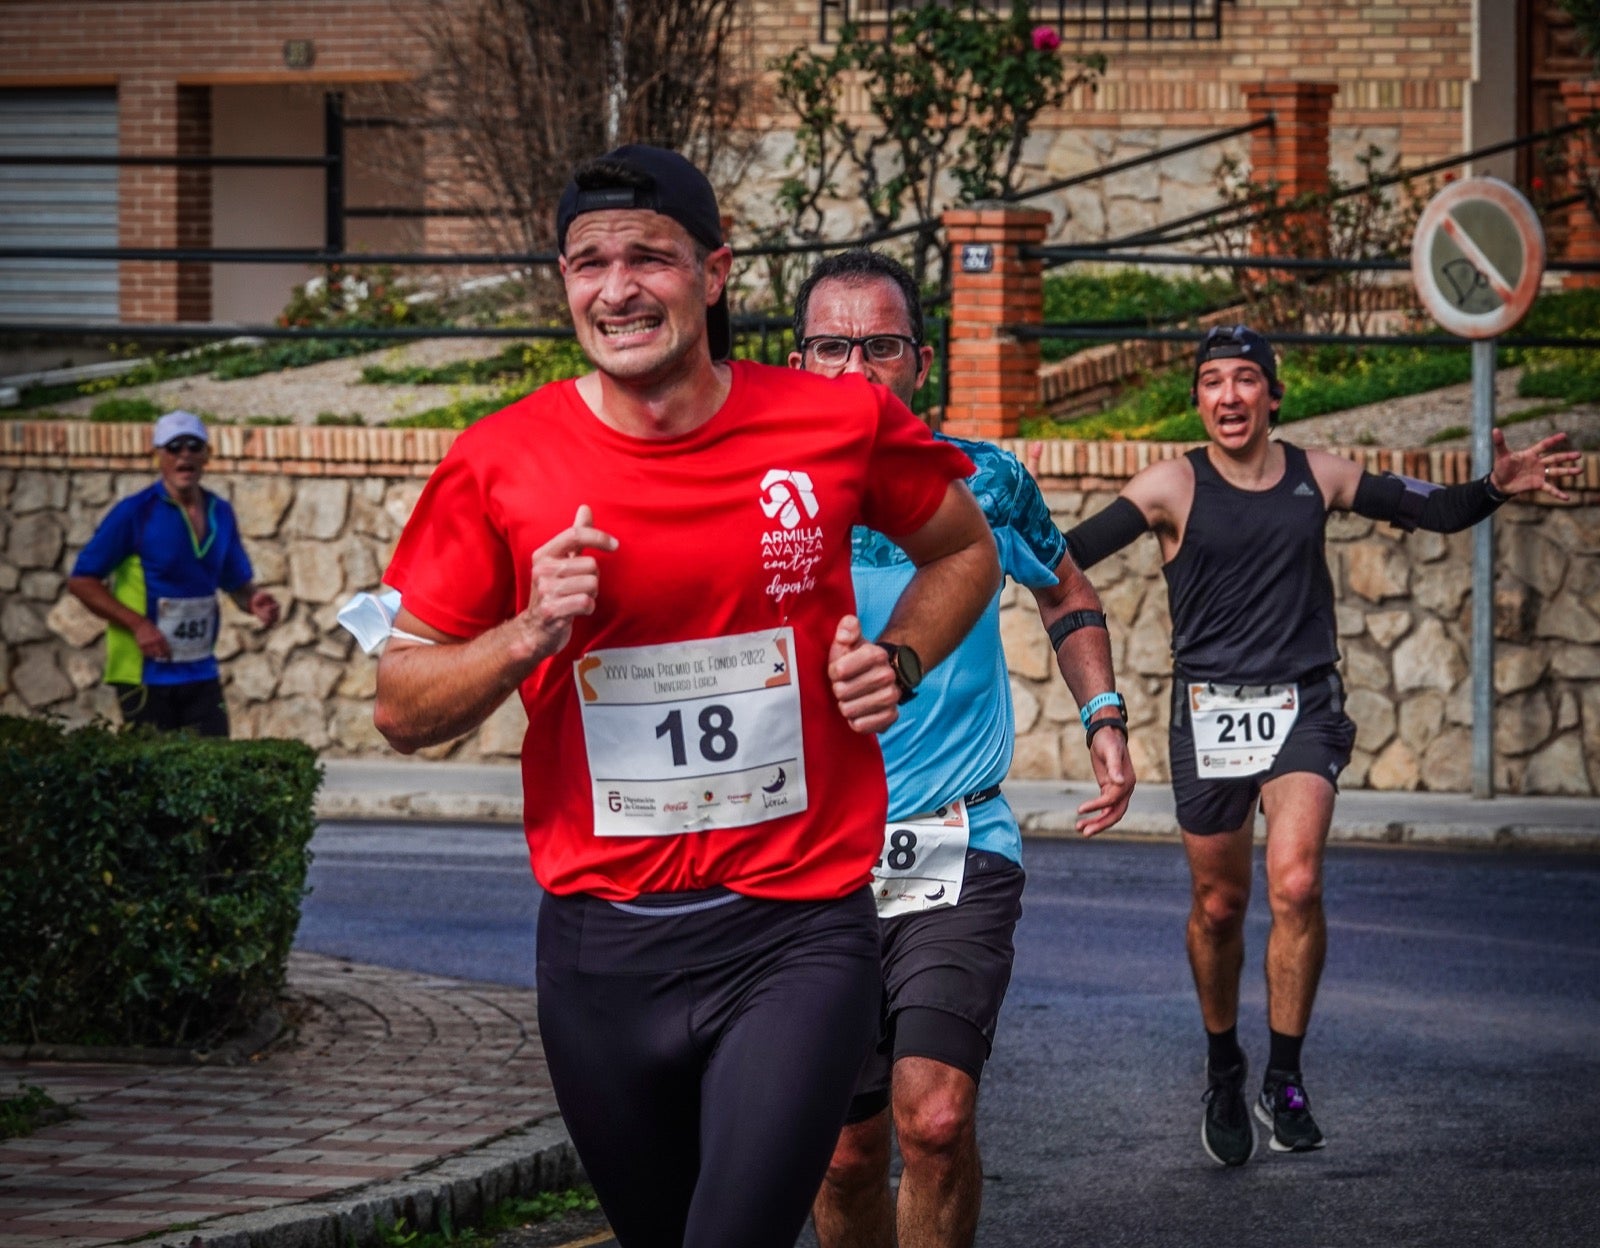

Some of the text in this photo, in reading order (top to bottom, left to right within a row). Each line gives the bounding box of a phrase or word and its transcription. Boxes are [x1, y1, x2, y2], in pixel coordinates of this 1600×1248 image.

[760, 526, 824, 545] ARMILLA
[762, 539, 824, 557] AVANZA
[763, 551, 822, 575] contigo
[603, 664, 628, 680] XXXV
[740, 649, 766, 667] 2022
[655, 704, 739, 767] 18
[1216, 711, 1275, 743] 210
[876, 829, 917, 870] 8
